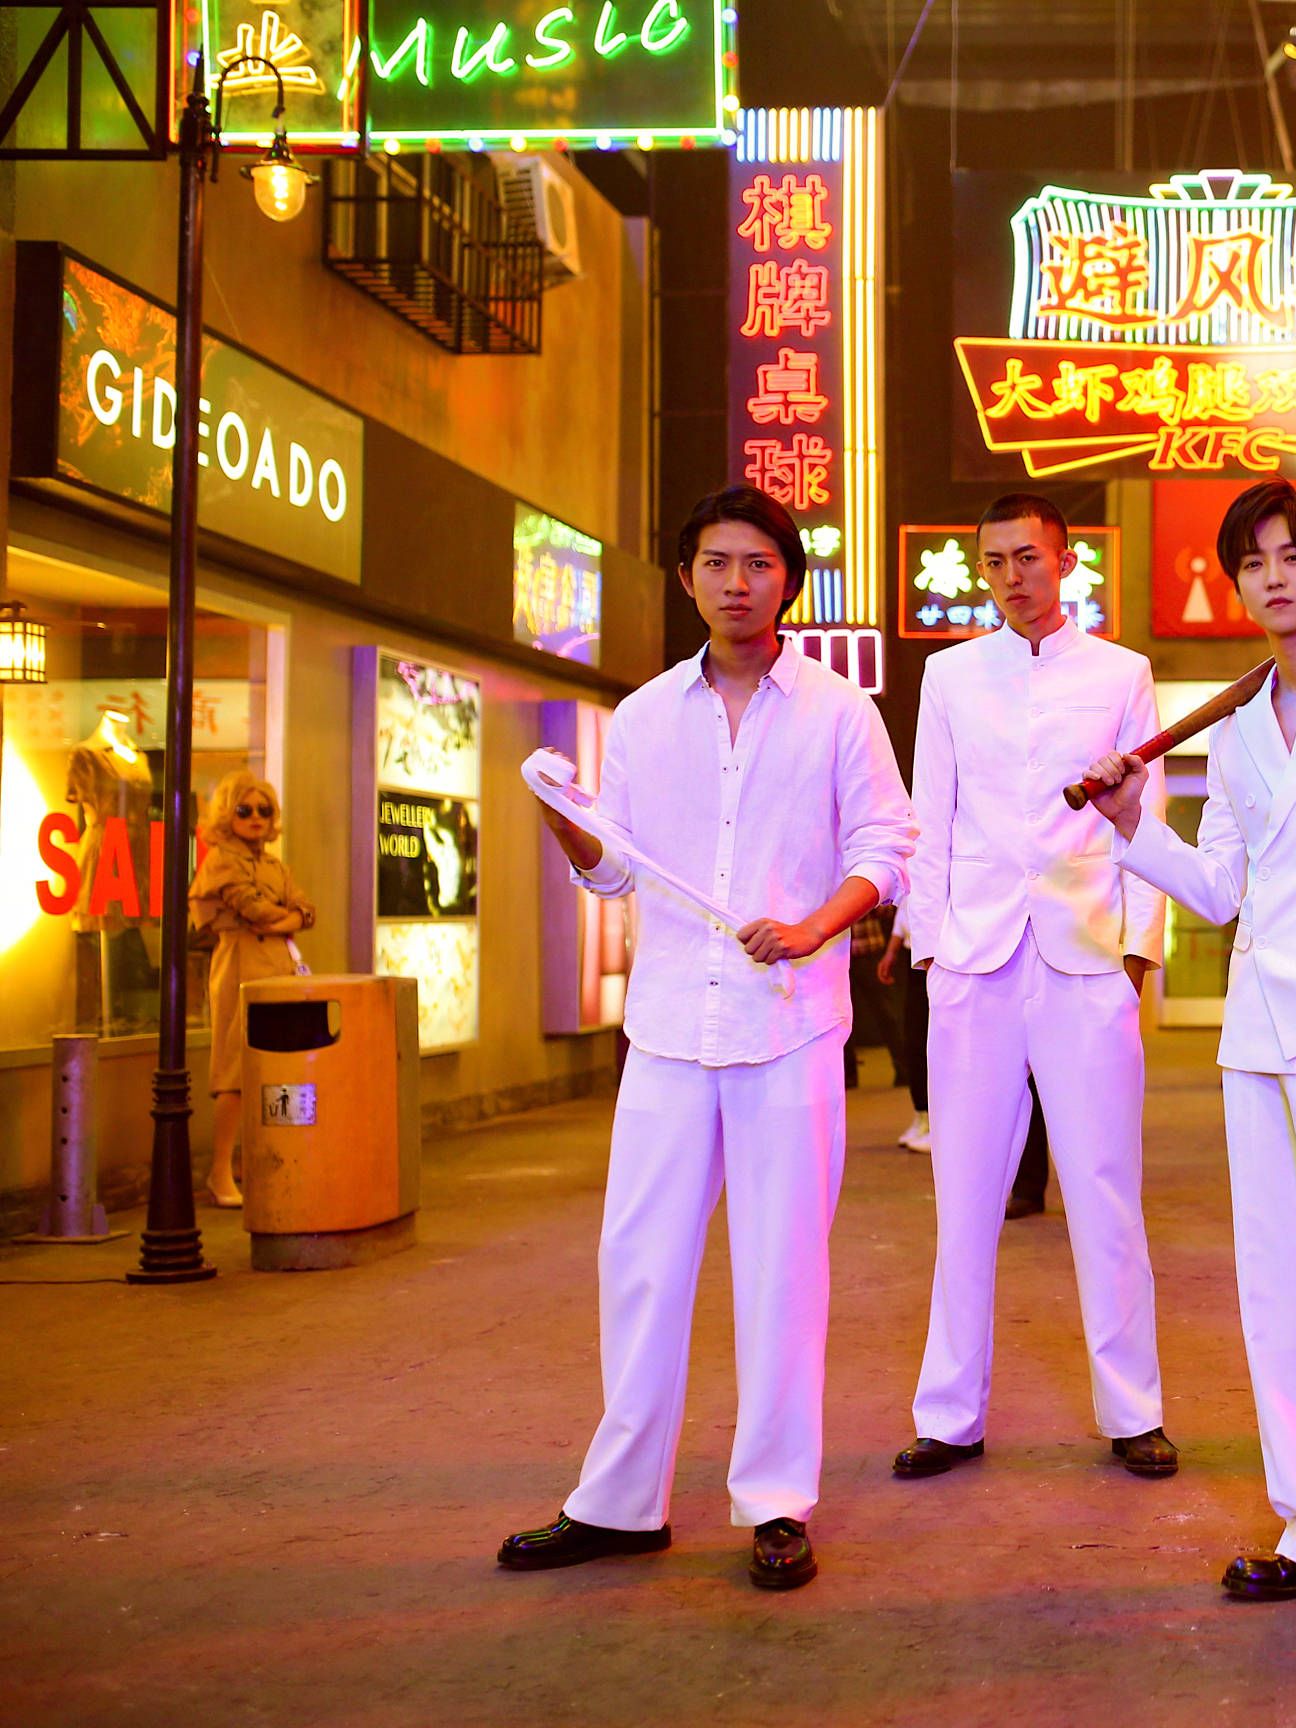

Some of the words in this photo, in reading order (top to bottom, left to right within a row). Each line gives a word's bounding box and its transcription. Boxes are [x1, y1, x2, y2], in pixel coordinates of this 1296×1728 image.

[738, 174, 833, 511] 棋牌桌球
[1148, 426, 1286, 471] KFC
[379, 833, 421, 859] WORLD
